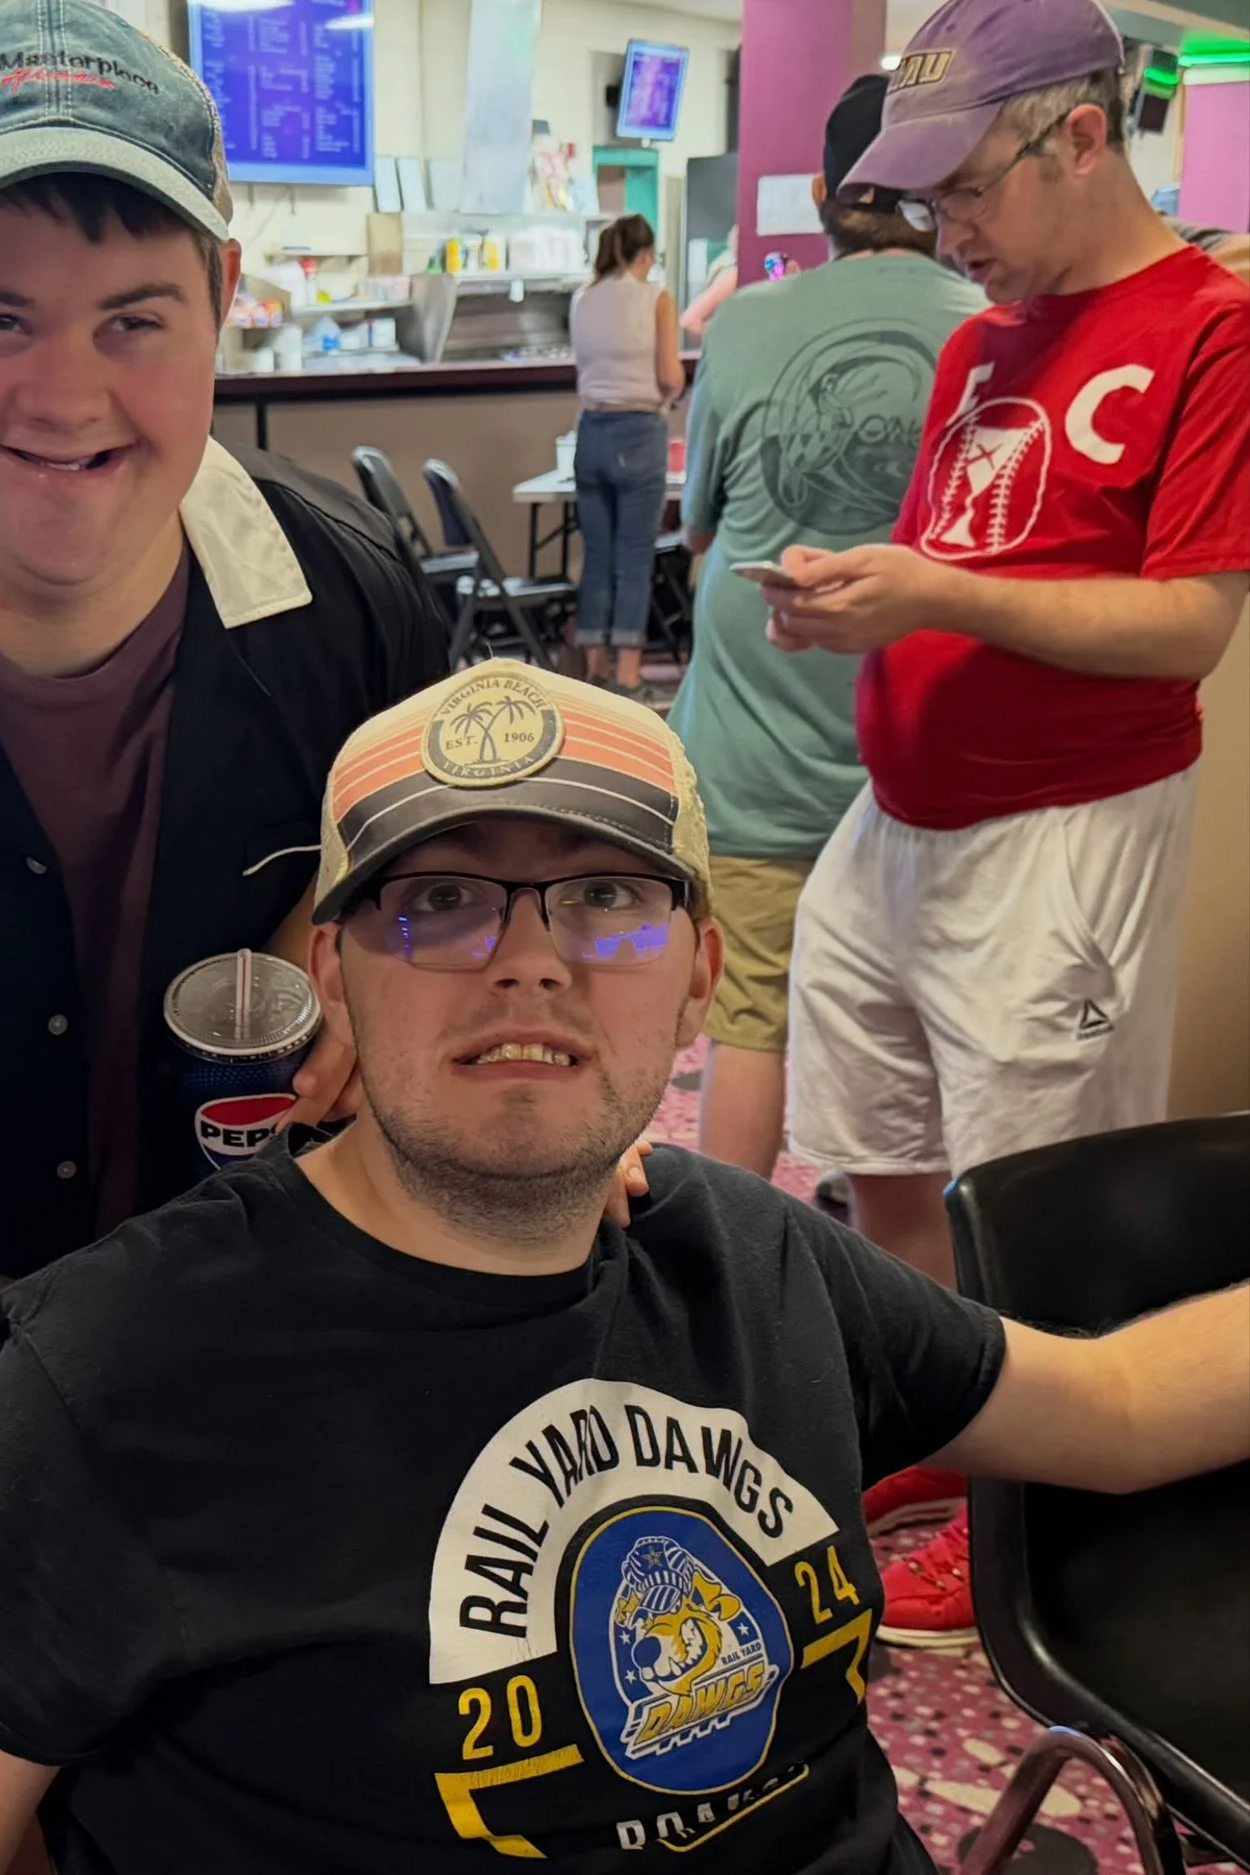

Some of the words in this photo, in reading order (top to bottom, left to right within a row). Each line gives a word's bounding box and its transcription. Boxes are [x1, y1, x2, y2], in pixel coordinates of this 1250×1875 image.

[440, 678, 500, 716] VIRGINIA
[502, 679, 547, 711] BEACH
[446, 736, 478, 751] EST.
[504, 732, 534, 743] 1906
[442, 756, 537, 778] VIRGINIA
[200, 1120, 279, 1148] PEP
[459, 1503, 549, 1638] RAIL
[510, 1404, 620, 1509] YARD
[624, 1403, 794, 1539] DAWGS
[794, 1545, 860, 1626] 24
[721, 1652, 741, 1665] RAIL
[741, 1642, 762, 1657] YARD
[458, 1674, 543, 1760] 20
[634, 1660, 766, 1746] DAWGS
